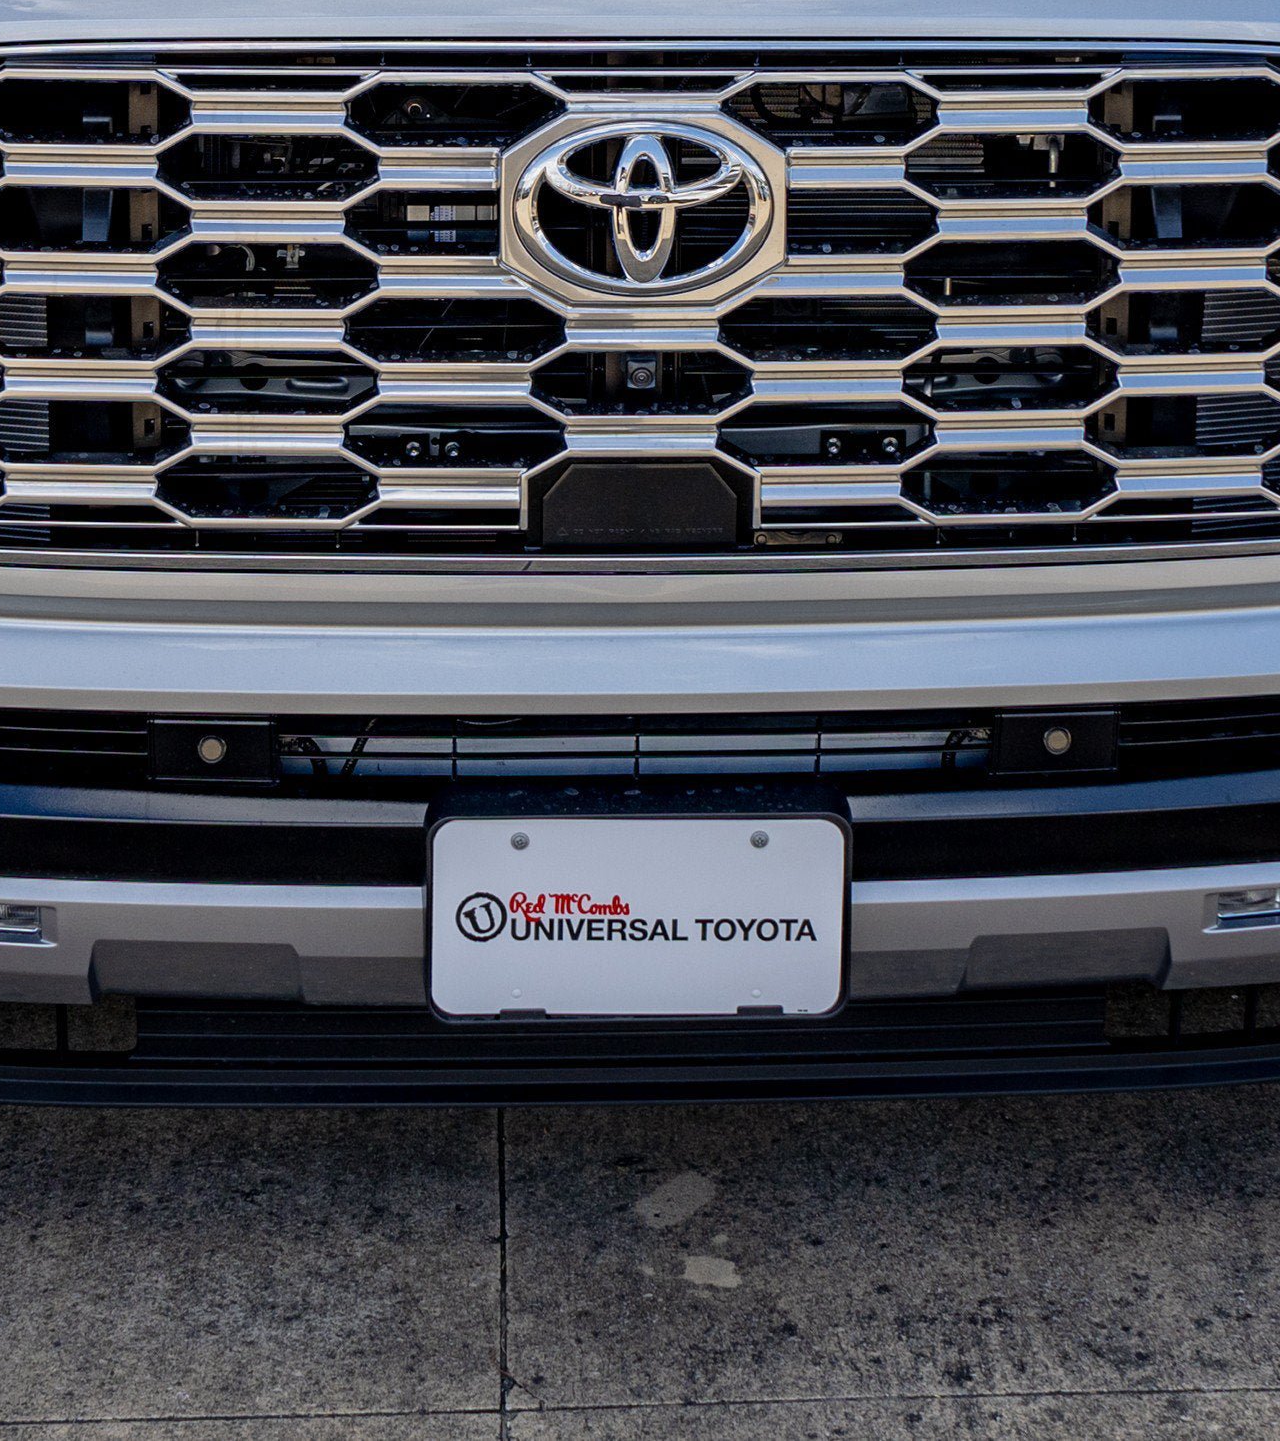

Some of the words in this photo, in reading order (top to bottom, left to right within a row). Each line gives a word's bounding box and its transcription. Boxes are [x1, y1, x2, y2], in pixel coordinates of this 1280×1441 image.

[509, 891, 546, 922] Red
[548, 892, 630, 916] McCombs
[510, 918, 689, 942] UNIVERSAL
[695, 918, 818, 942] TOYOTA
